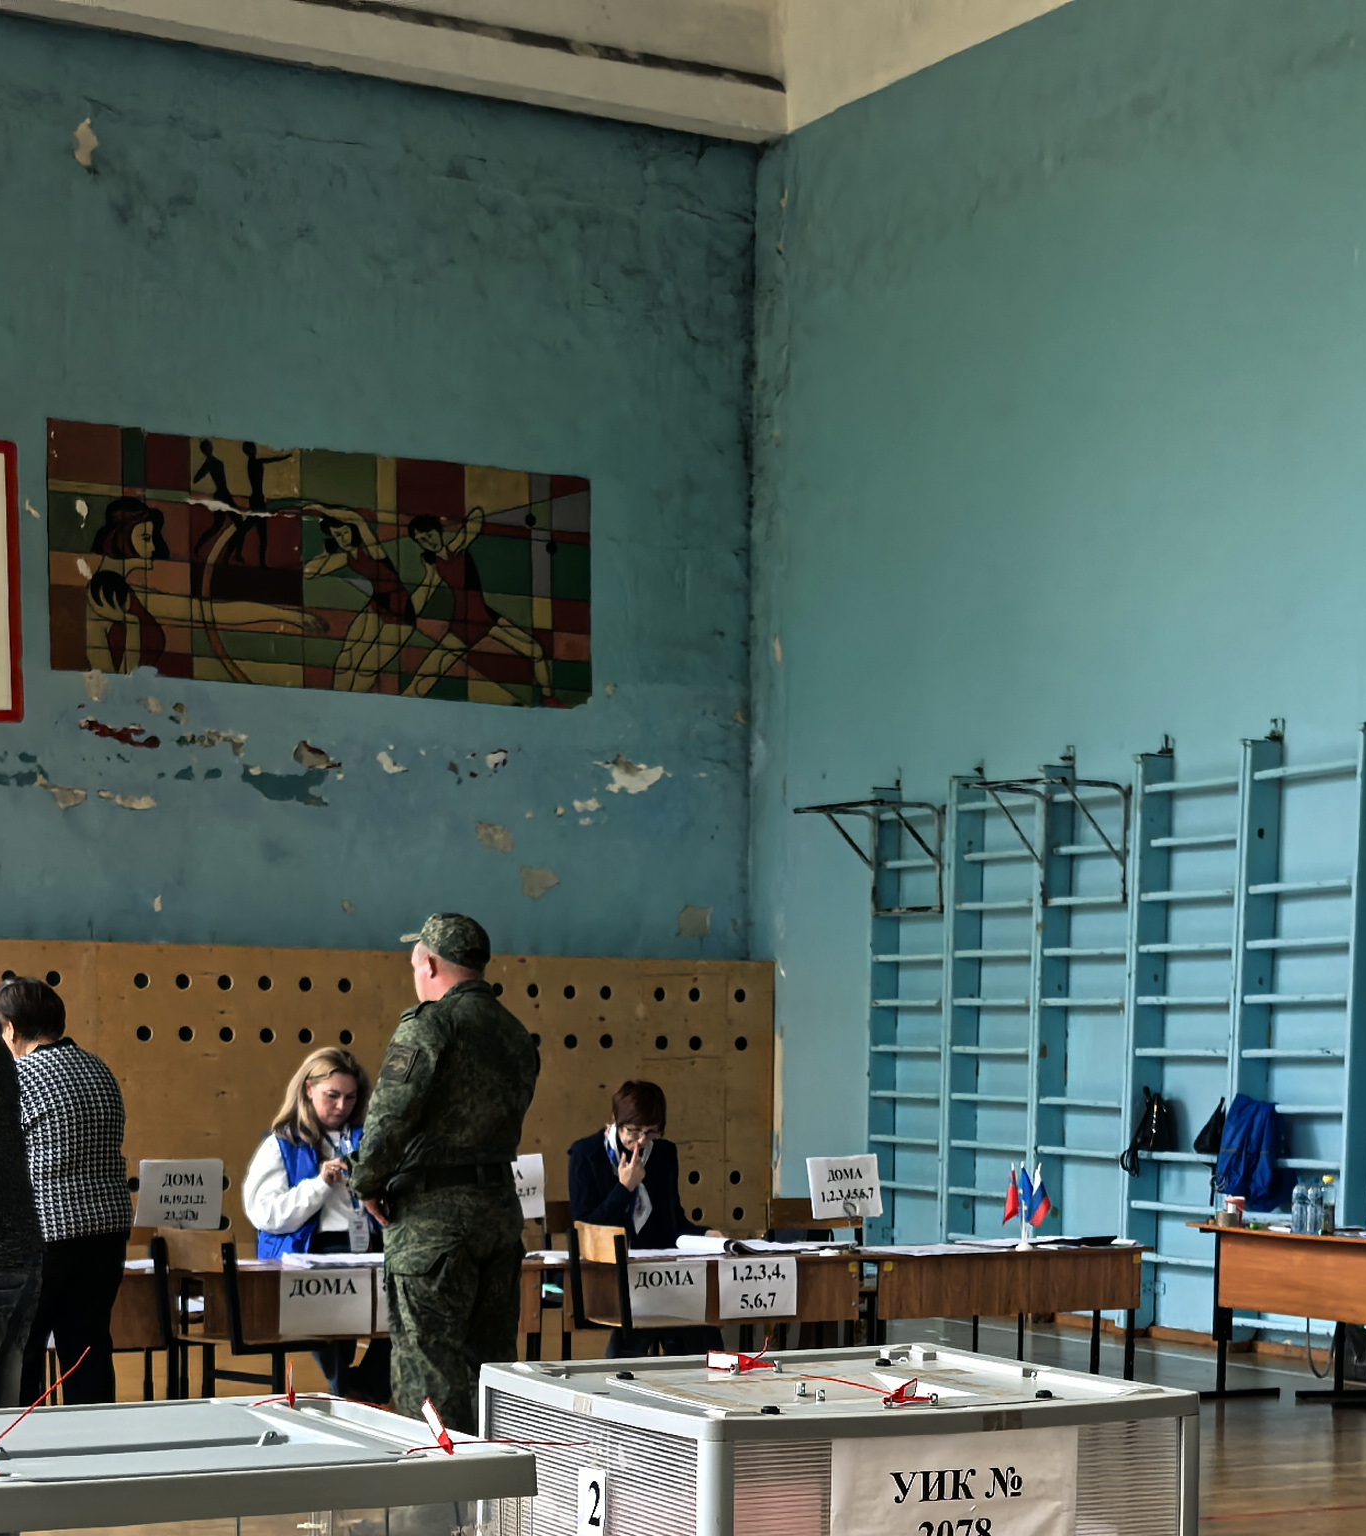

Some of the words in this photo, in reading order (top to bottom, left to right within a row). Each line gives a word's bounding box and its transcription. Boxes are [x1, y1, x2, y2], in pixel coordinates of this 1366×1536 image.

[162, 1172, 204, 1188] ДОМА
[827, 1168, 863, 1183] ДОМА
[635, 1270, 695, 1289] ДОМА
[732, 1263, 786, 1283] 1,2,3,4,
[289, 1278, 357, 1298] ДОМА
[740, 1292, 776, 1310] 5,6,7
[889, 1468, 977, 1504] УИК
[985, 1466, 1023, 1499] №
[588, 1480, 601, 1526] 2
